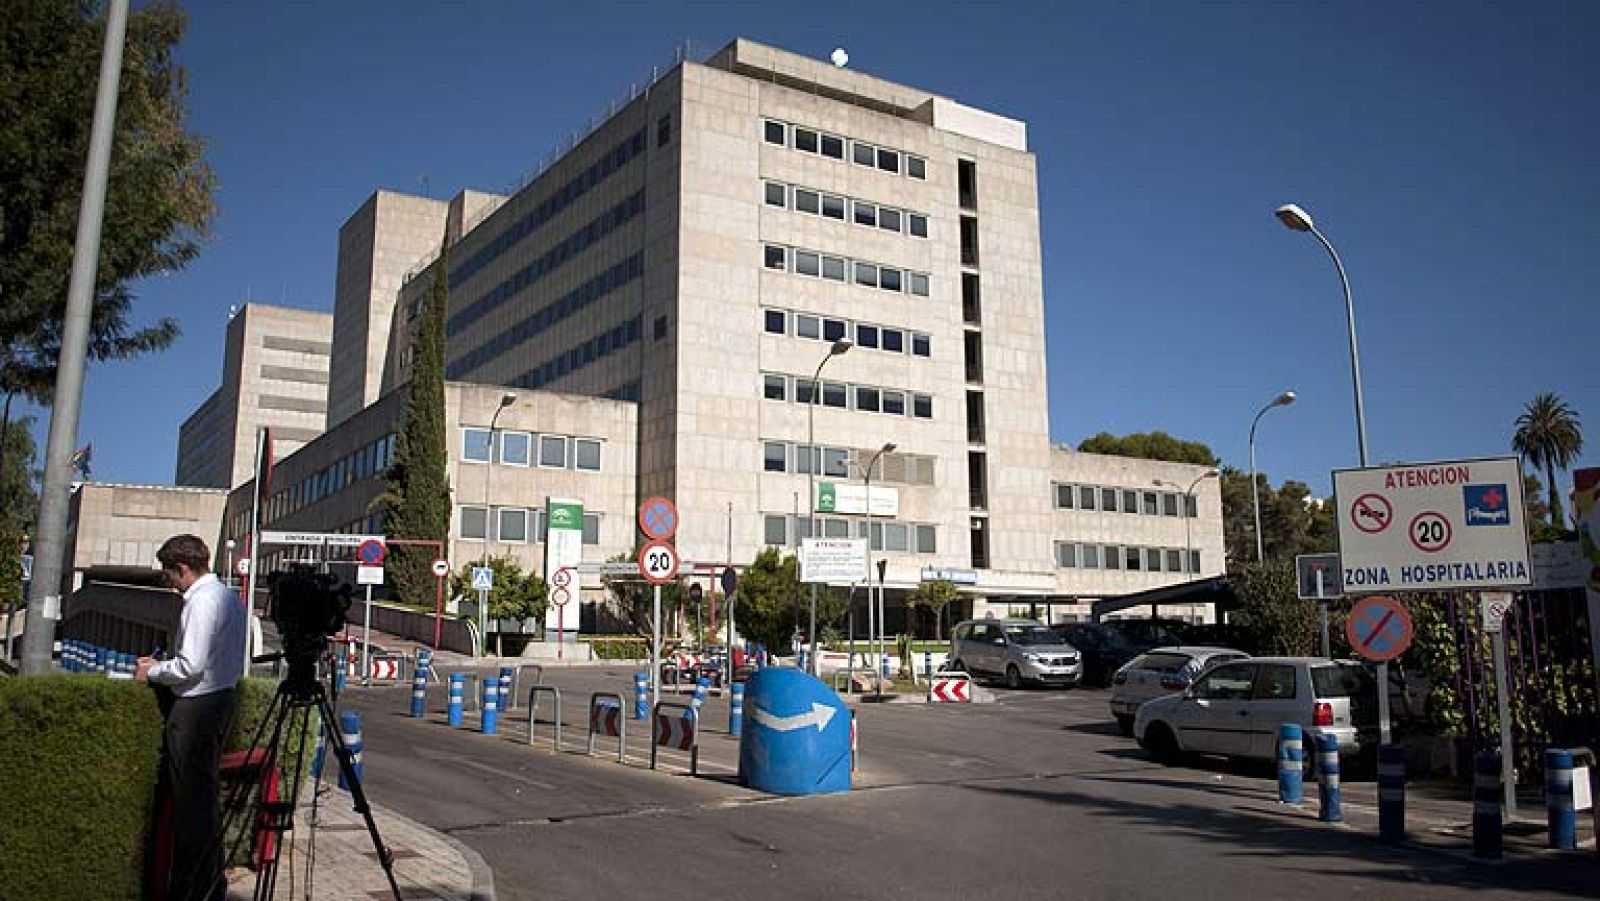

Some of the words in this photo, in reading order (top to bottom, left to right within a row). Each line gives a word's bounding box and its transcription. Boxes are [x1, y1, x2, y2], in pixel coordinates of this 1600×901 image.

[1385, 465, 1470, 488] ATENCION
[1418, 520, 1444, 542] 20
[649, 552, 670, 572] 20
[1345, 567, 1391, 585] ZONA
[1401, 560, 1526, 583] HOSPITALARIA
